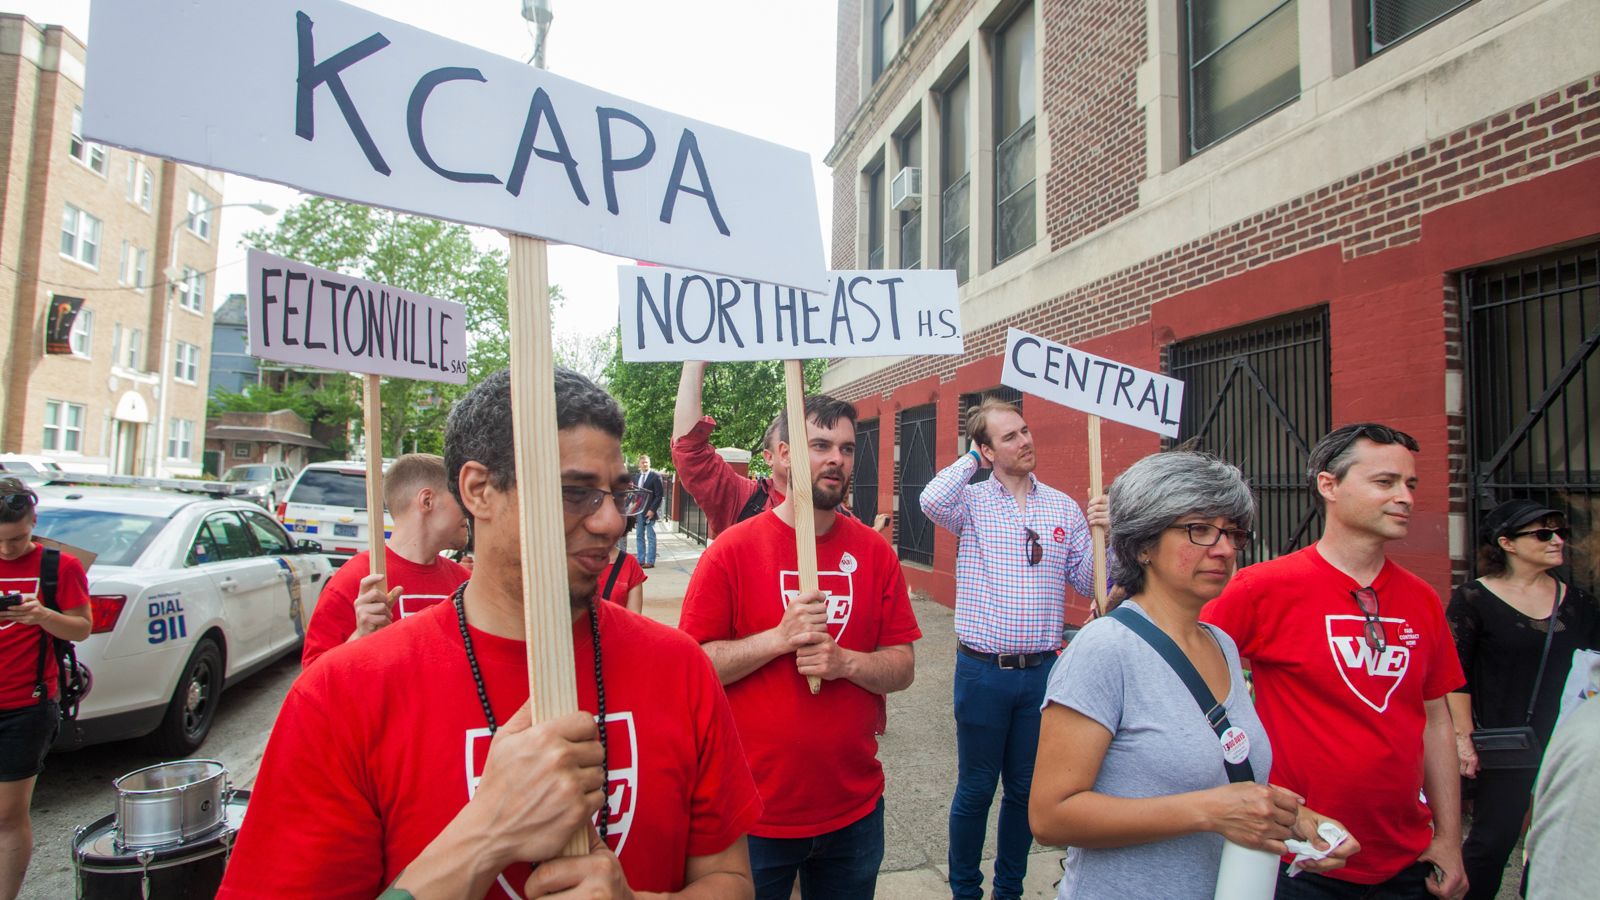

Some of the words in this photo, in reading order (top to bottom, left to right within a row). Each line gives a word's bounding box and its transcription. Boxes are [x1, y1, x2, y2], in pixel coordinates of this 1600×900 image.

[296, 11, 730, 237] KCAPA
[262, 268, 452, 372] FELTONVILLE
[451, 360, 467, 374] SAS
[637, 273, 904, 349] NORTHEAST
[918, 309, 960, 339] H.S.
[1012, 337, 1179, 425] CENTRAL
[148, 599, 184, 617] DIAL
[148, 615, 187, 644] 911
